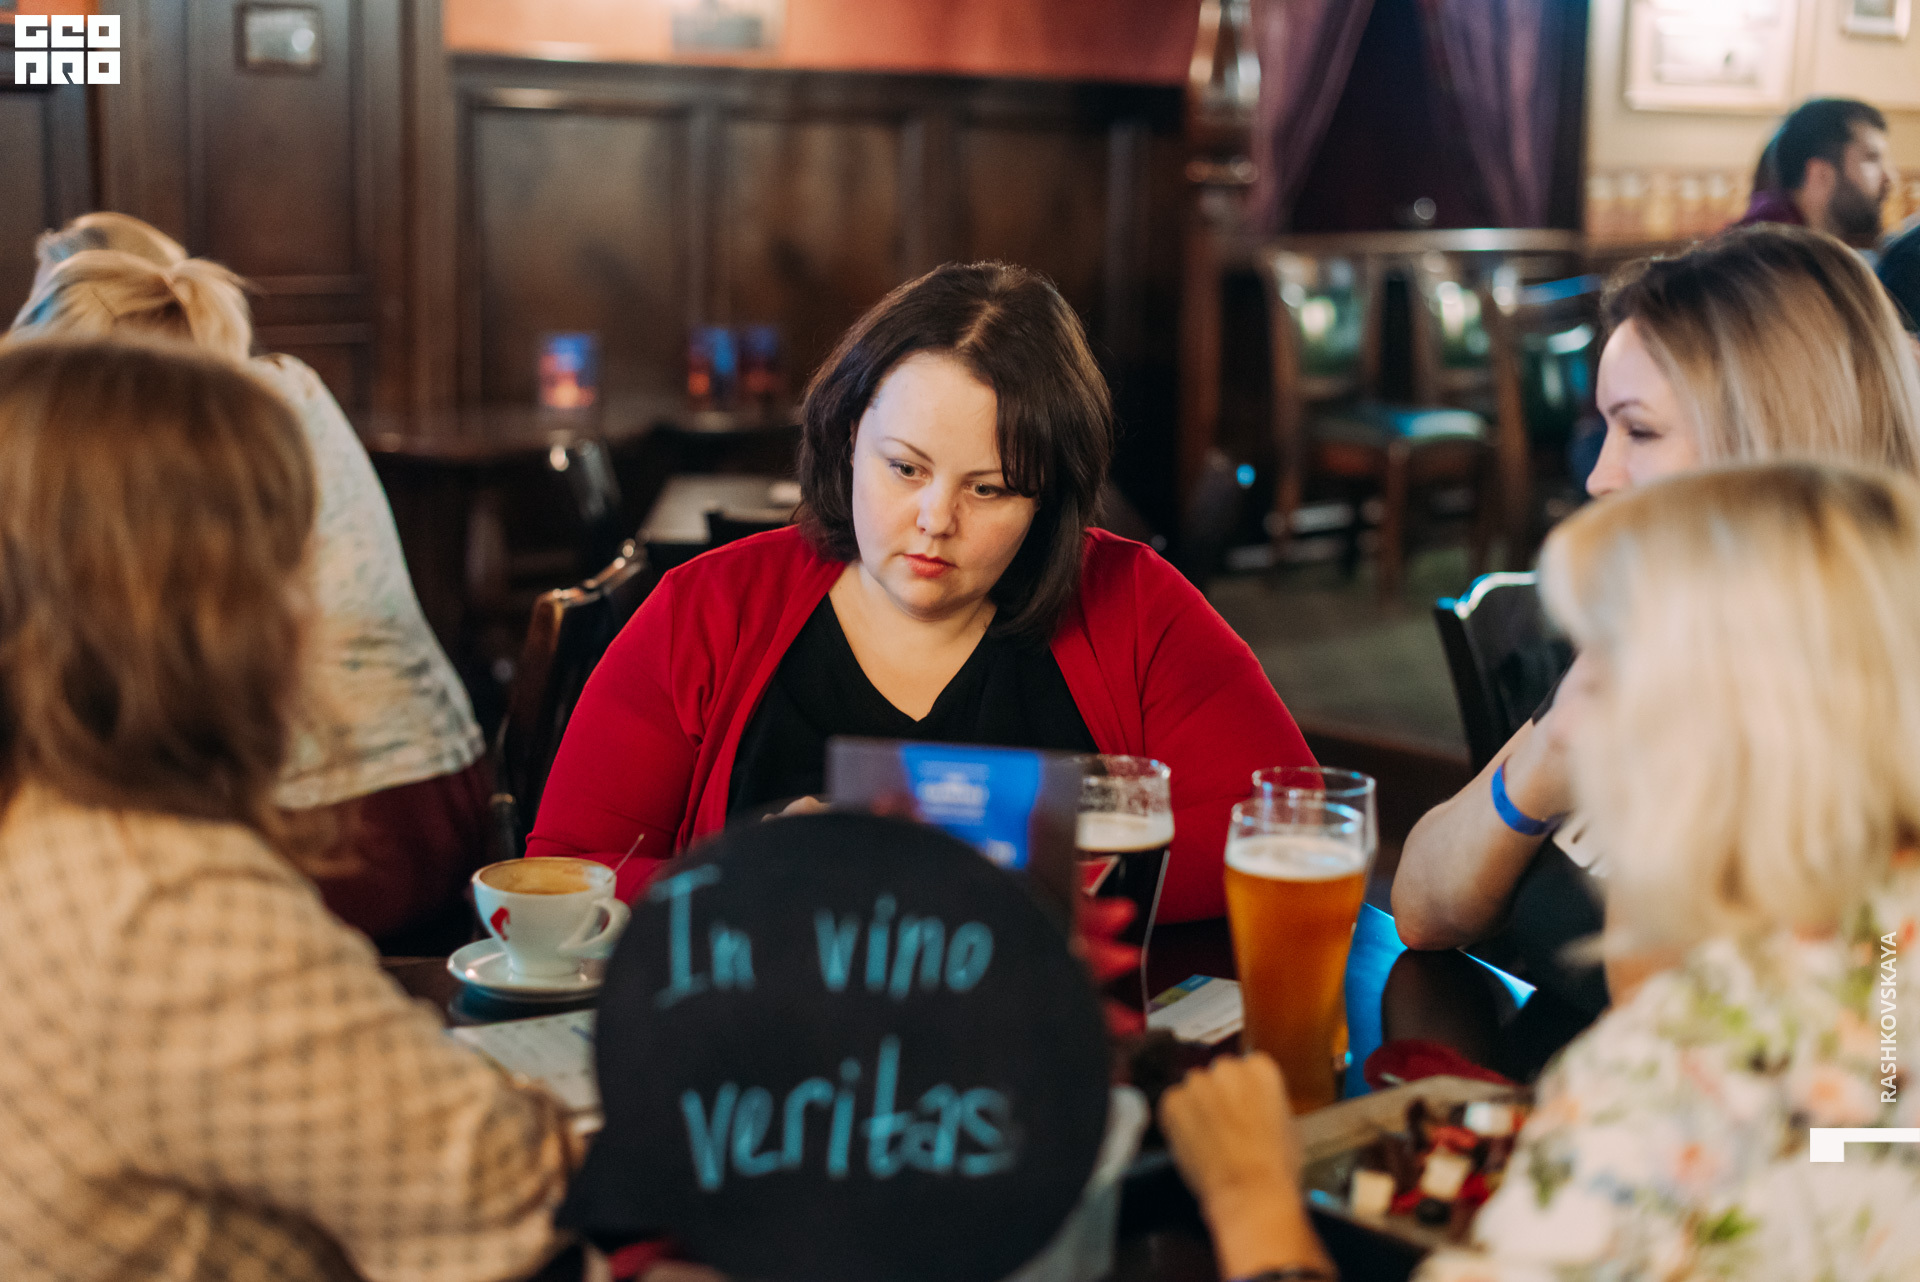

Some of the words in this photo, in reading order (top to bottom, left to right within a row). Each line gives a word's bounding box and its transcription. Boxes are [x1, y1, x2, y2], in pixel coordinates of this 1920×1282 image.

[653, 864, 754, 1008] In
[813, 892, 994, 1000] vino
[681, 1034, 1019, 1191] veritas
